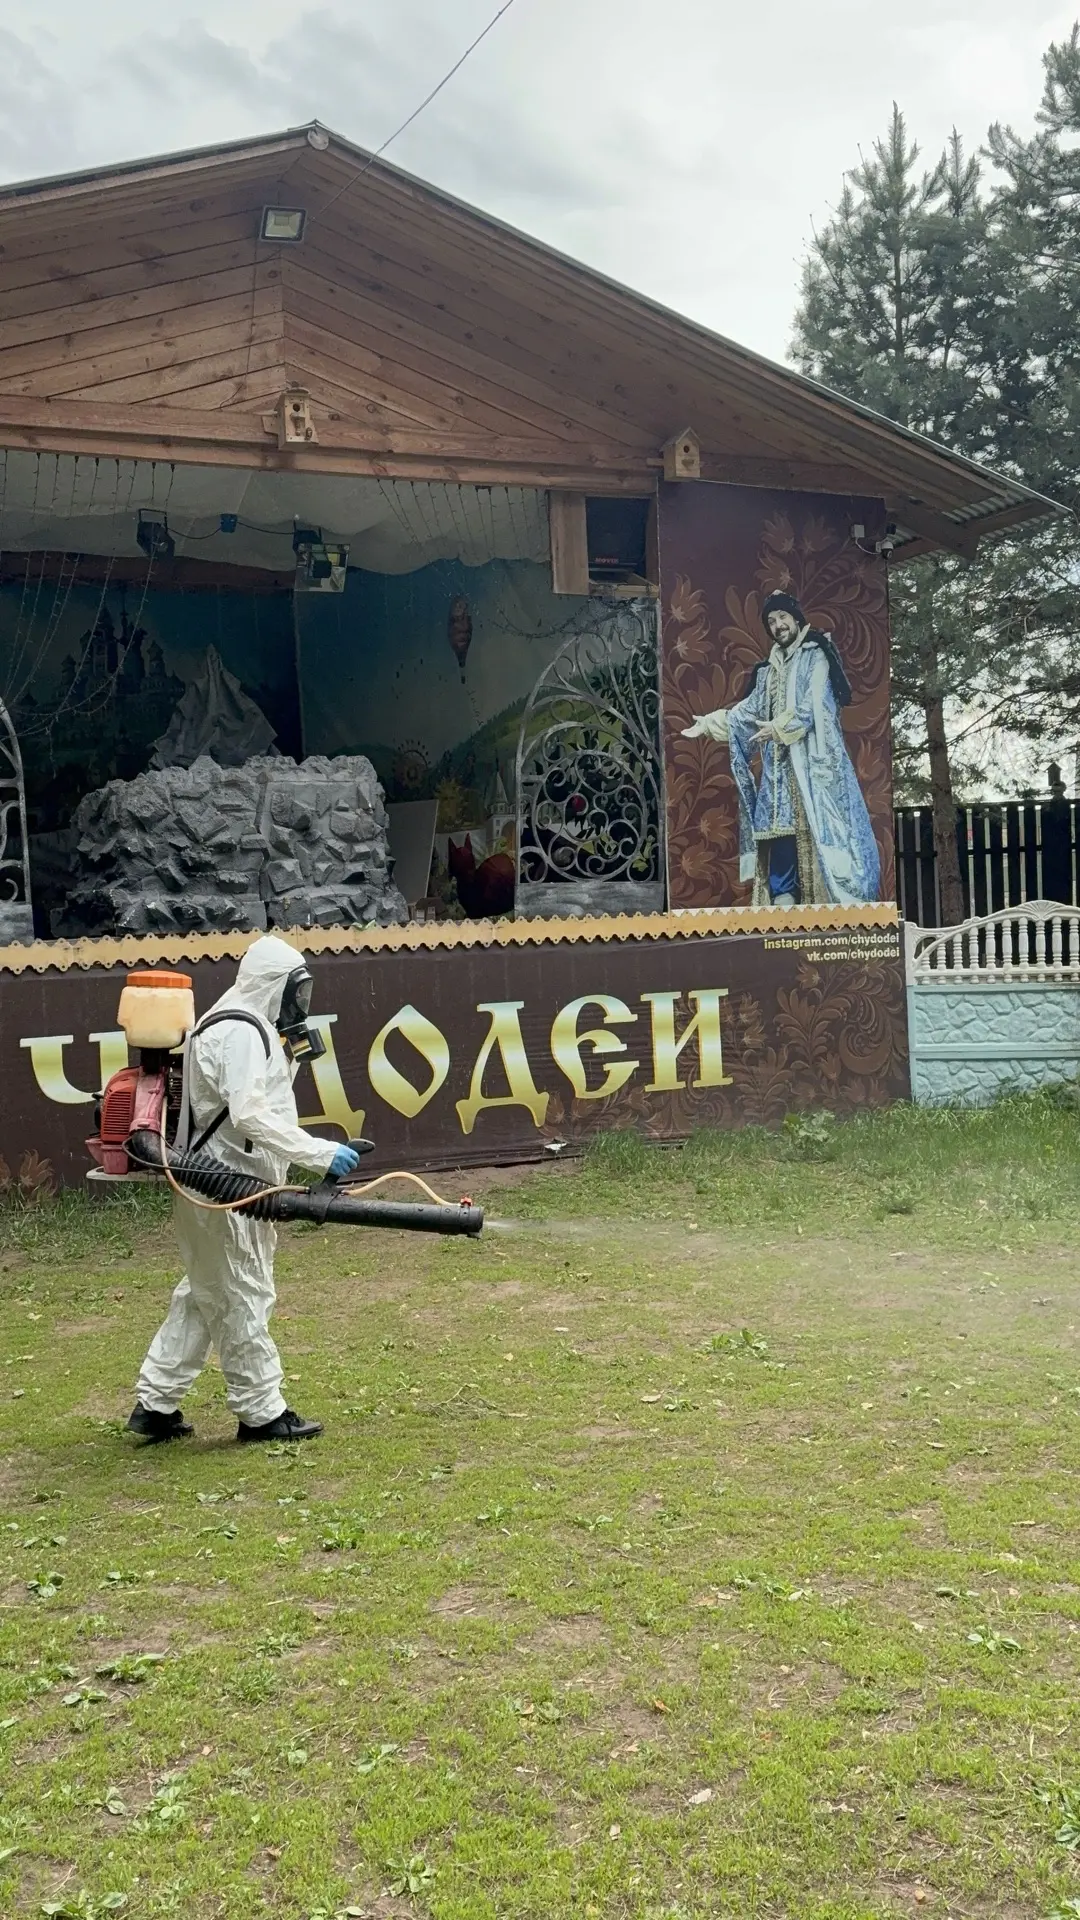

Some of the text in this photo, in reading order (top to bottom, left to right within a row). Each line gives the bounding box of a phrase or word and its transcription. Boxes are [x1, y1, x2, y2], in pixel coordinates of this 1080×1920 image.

[764, 932, 900, 950] instagram.com/chydodei
[807, 947, 900, 962] vk.com/chydodei
[19, 987, 734, 1140] ЧДОДЕИ
